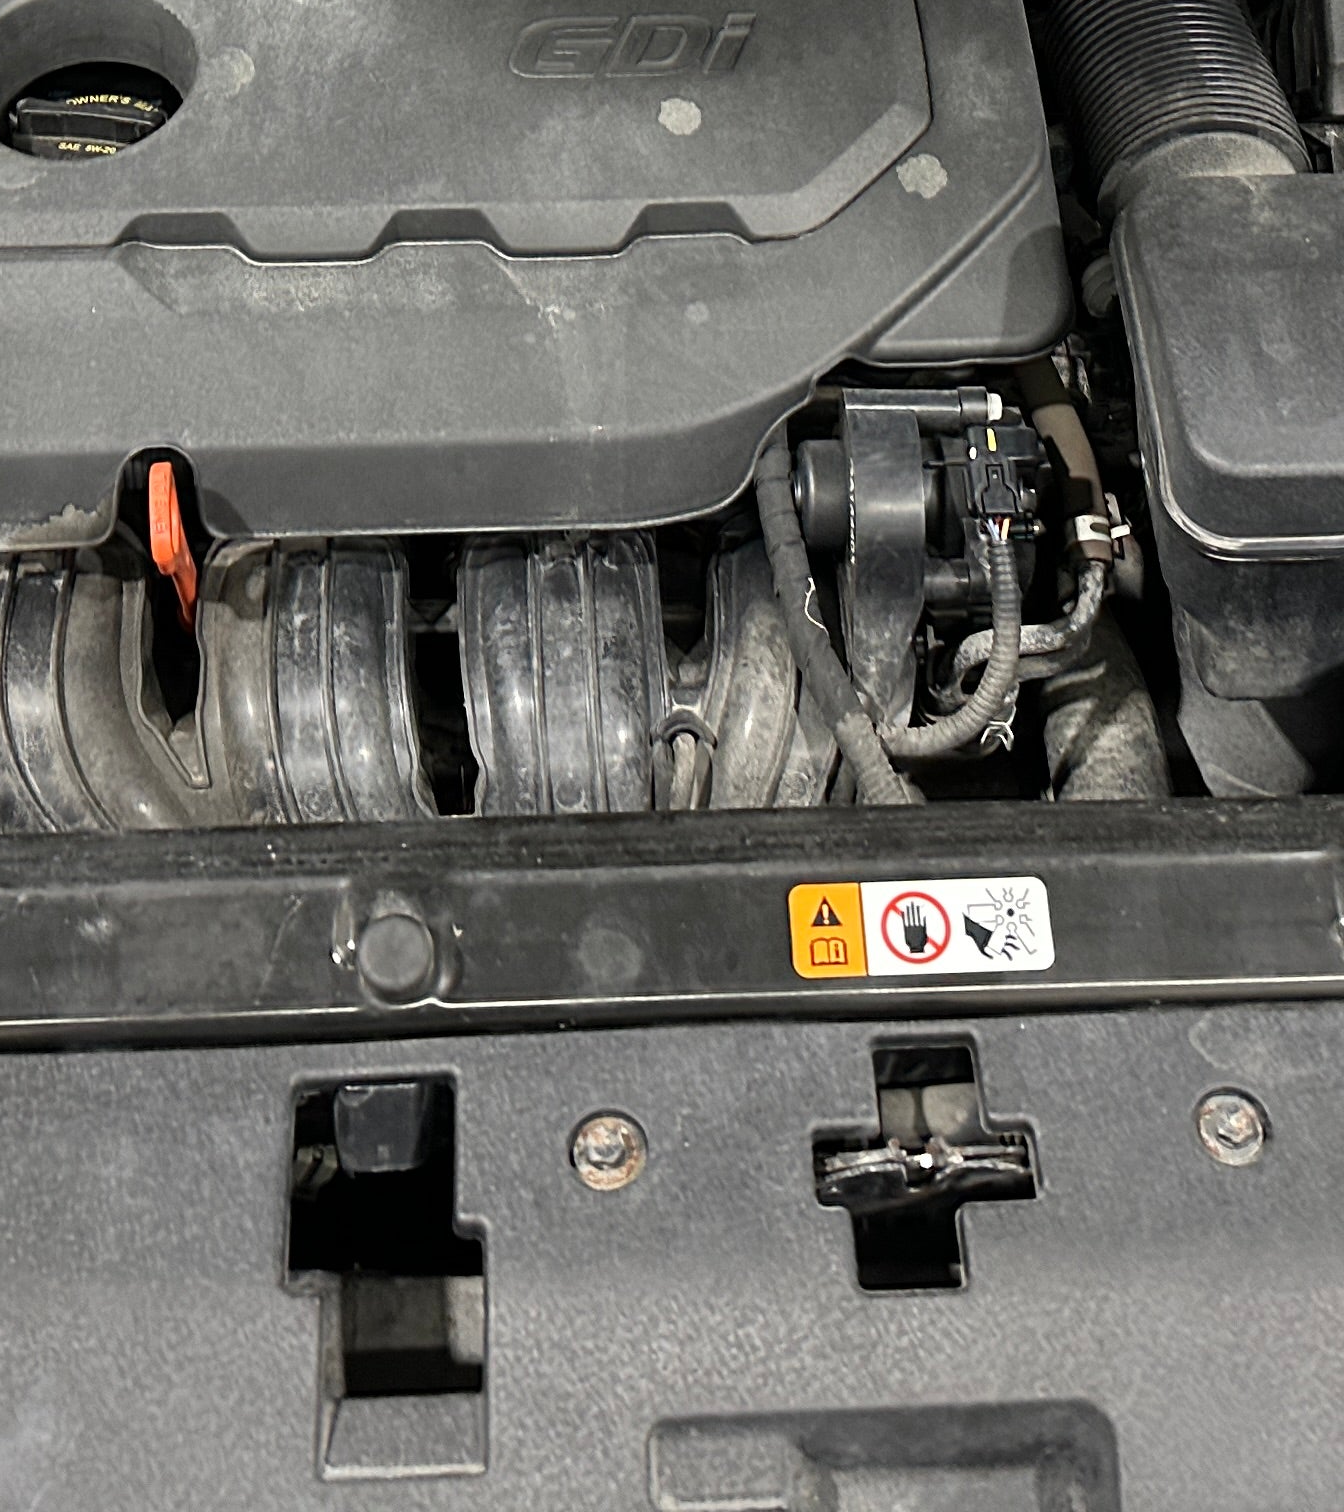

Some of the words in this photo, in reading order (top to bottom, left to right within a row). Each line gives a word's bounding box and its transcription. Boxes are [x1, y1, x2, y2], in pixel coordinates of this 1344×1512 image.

[507, 10, 758, 79] GDi
[58, 142, 81, 152] SAE
[85, 144, 117, 155] 5W-20
